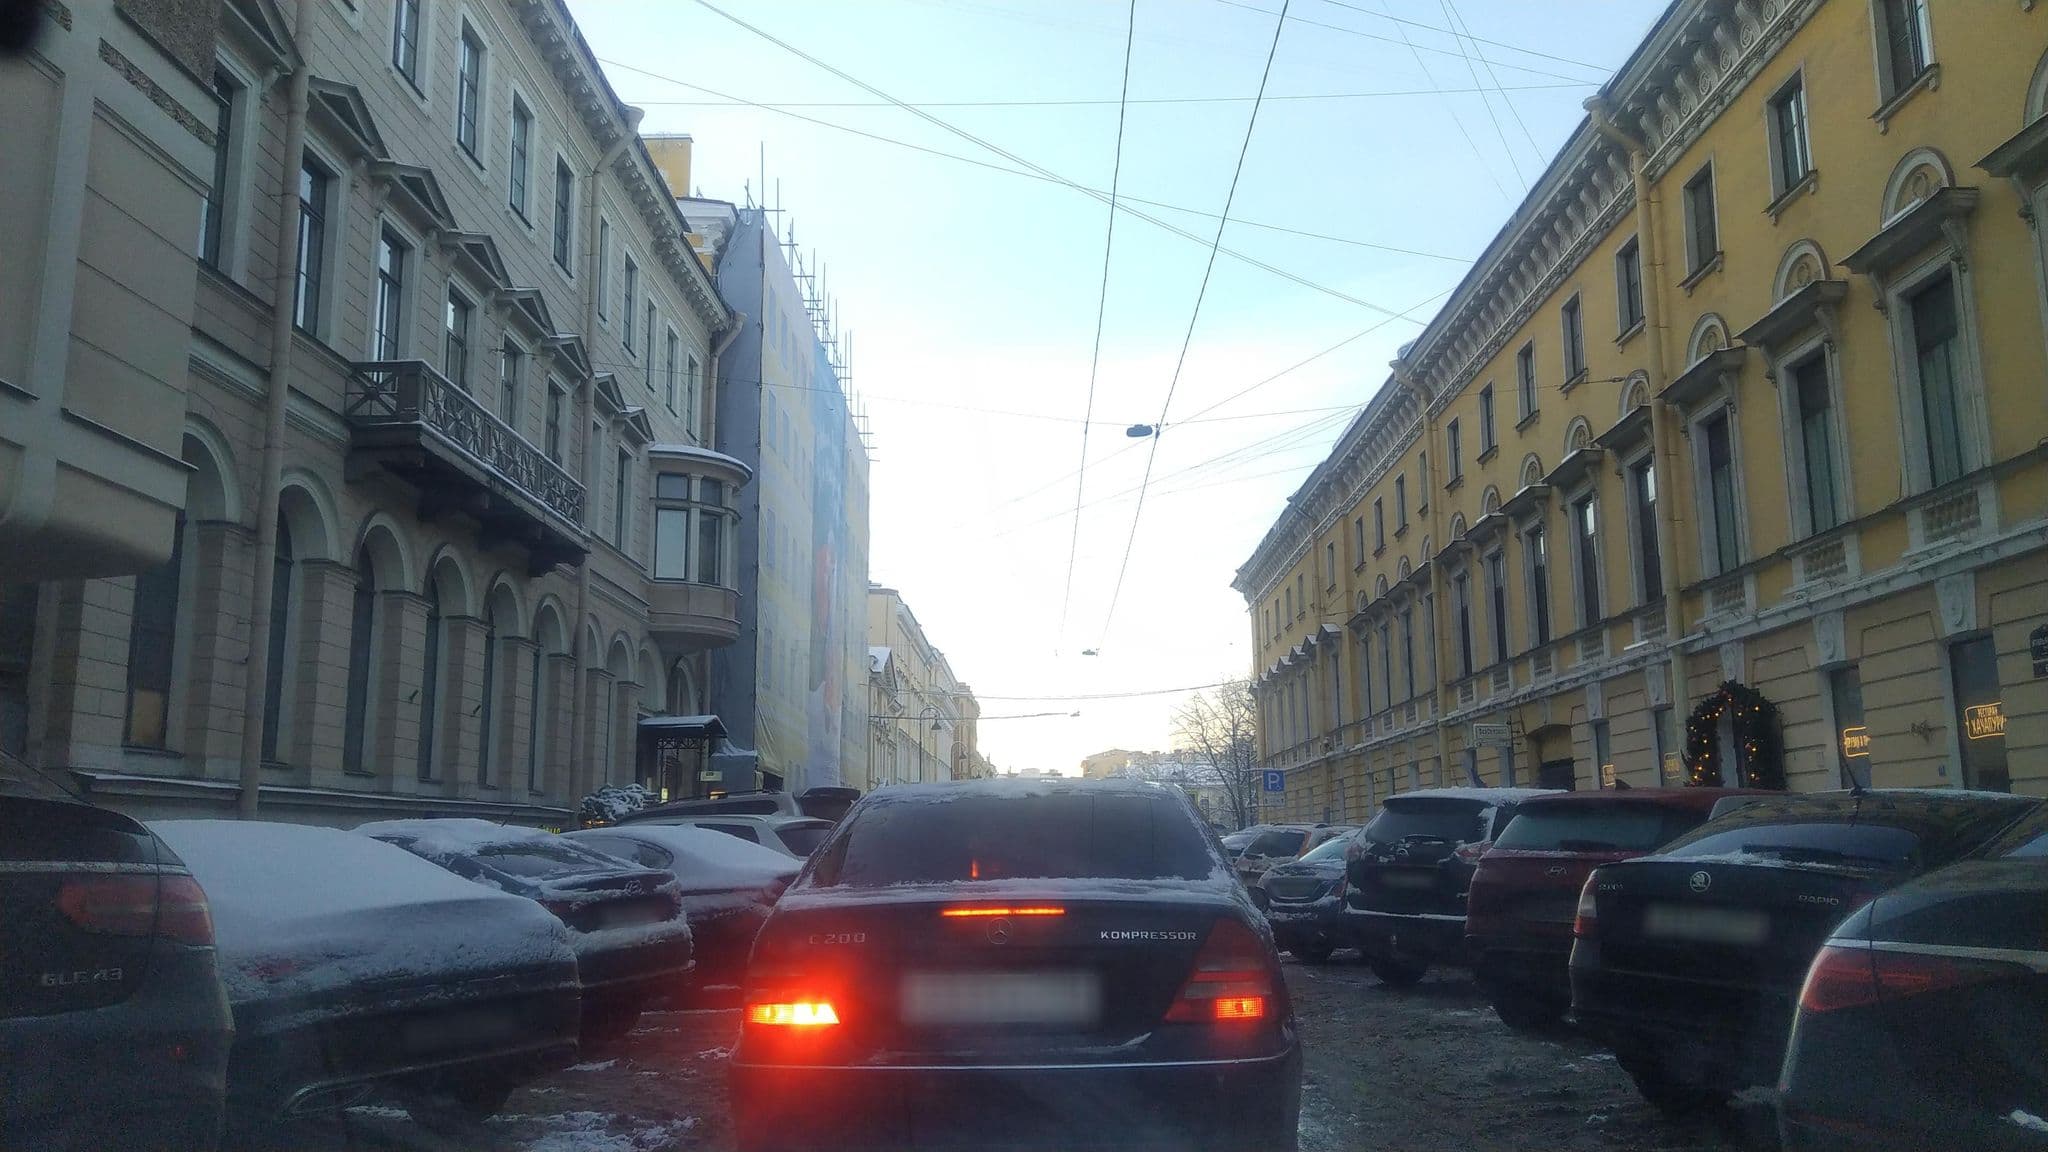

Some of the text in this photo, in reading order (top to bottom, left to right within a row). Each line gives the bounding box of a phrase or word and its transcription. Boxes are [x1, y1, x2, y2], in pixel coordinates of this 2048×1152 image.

[1267, 772, 1280, 790] P
[823, 932, 866, 945] 200
[1100, 930, 1197, 941] KOMPRESSOR
